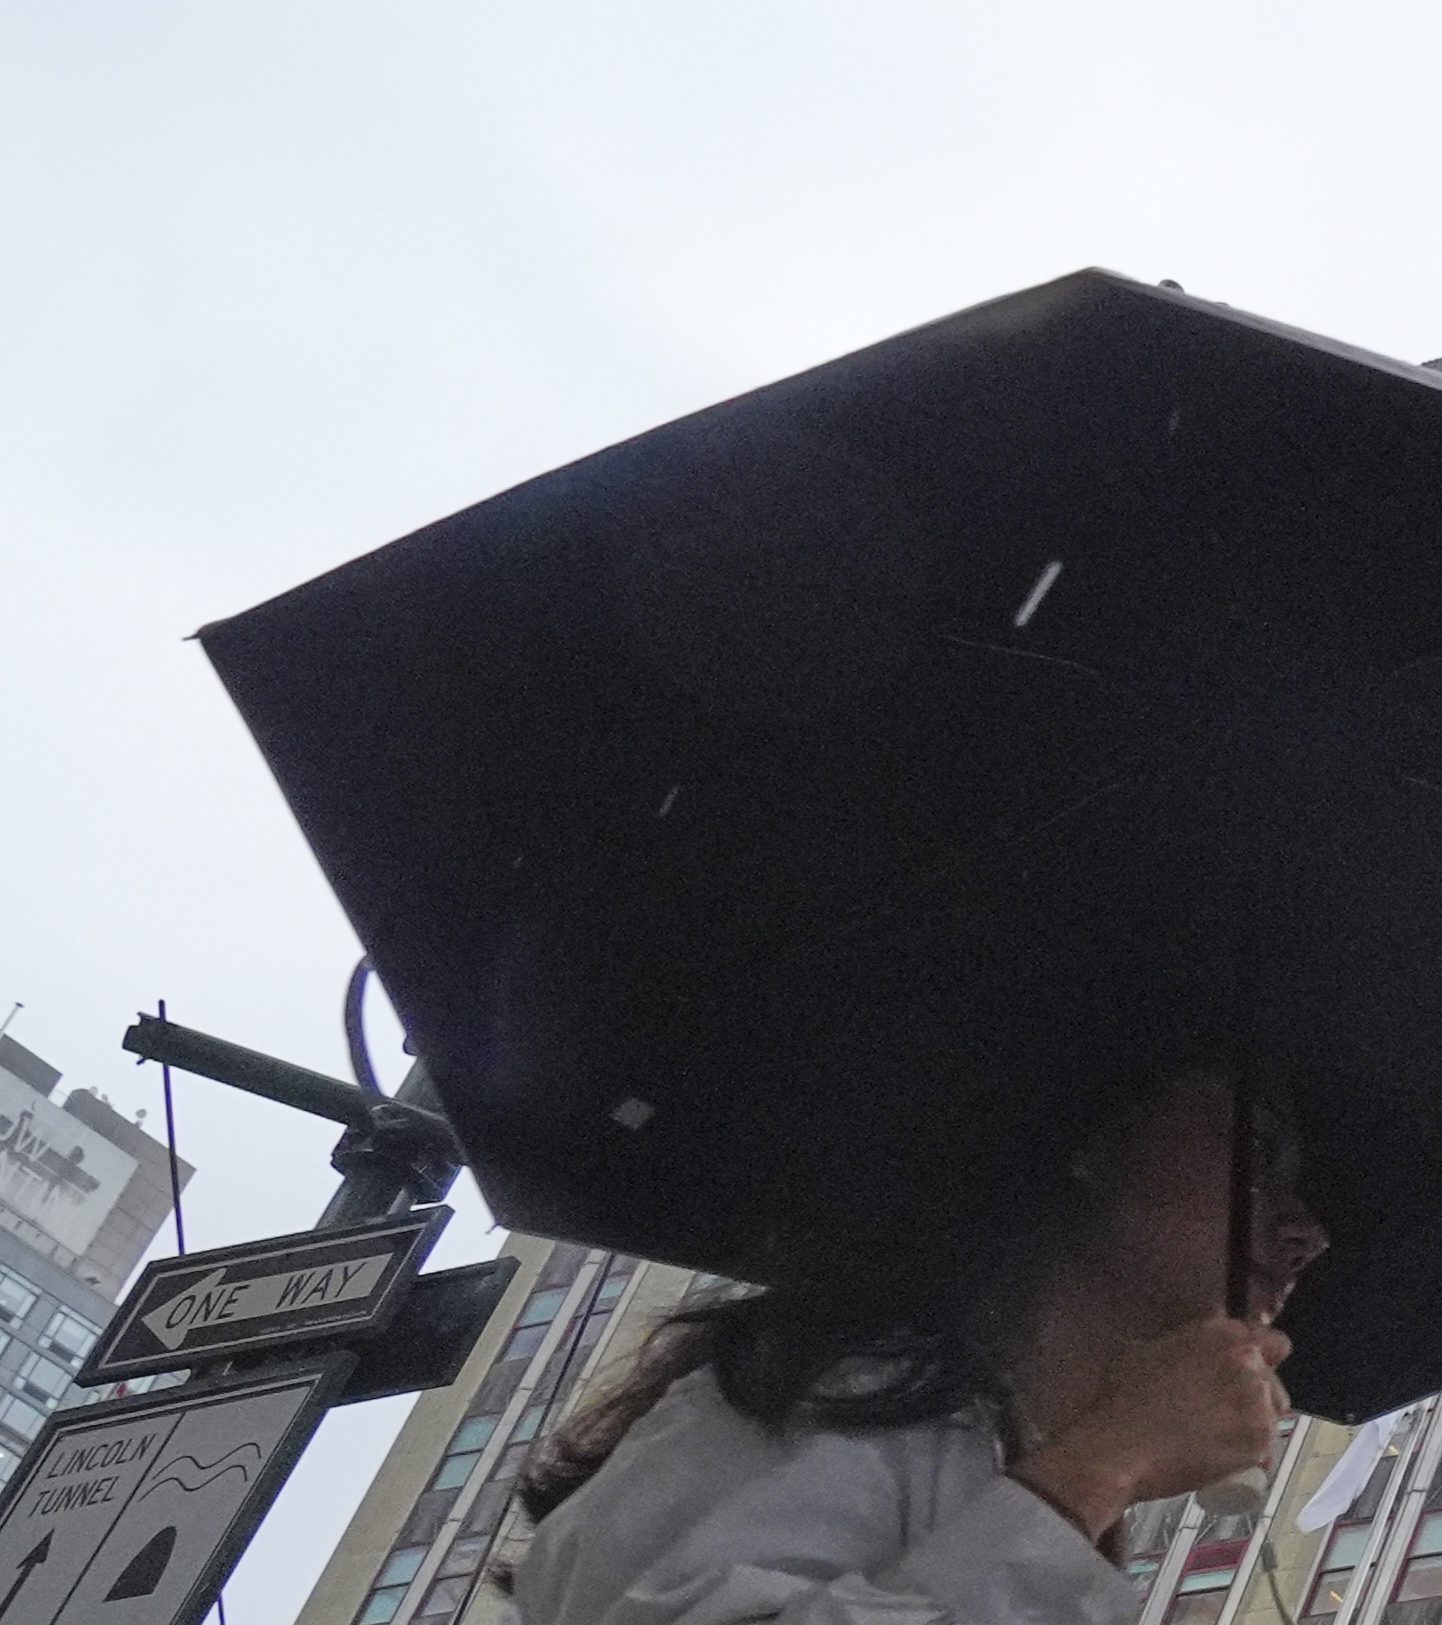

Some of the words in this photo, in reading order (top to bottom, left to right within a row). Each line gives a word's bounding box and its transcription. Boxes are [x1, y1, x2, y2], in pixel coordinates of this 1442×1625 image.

[165, 1283, 250, 1330] ONE
[275, 1261, 368, 1311] WAY
[47, 1433, 157, 1479] LINCOLN
[28, 1475, 120, 1518] TUNNEL
